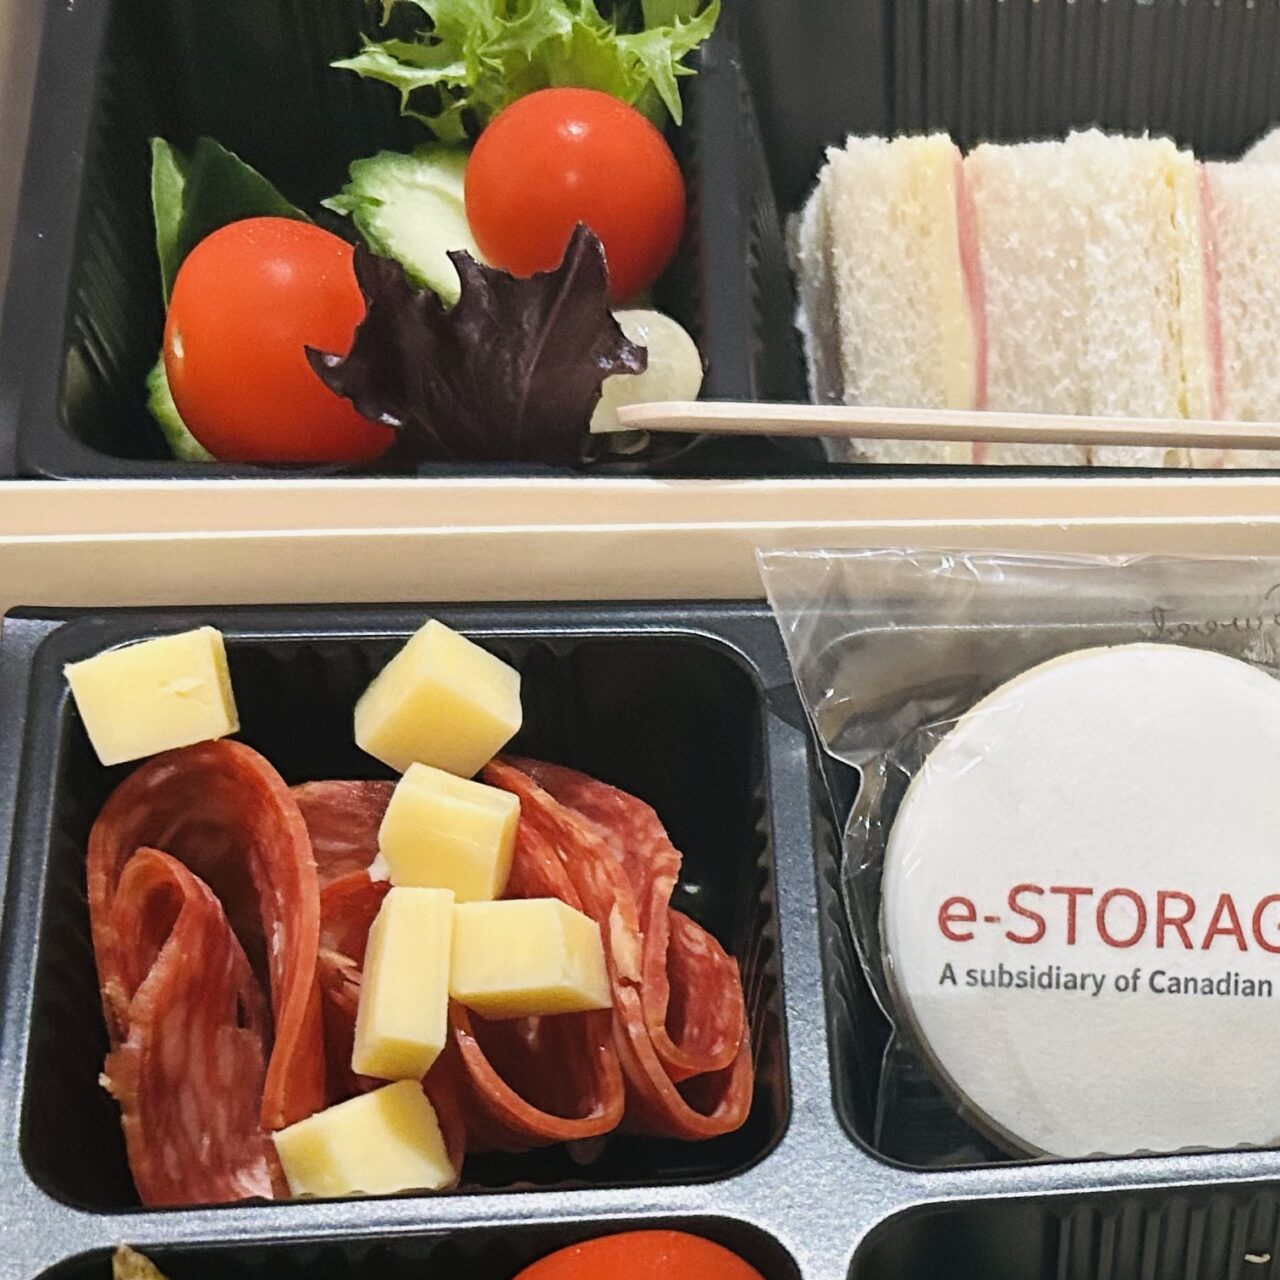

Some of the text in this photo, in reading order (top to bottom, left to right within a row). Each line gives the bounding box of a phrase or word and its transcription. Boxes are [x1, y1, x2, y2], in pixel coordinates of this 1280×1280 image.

[939, 962, 958, 986] A
[966, 963, 1106, 997] subsidiary
[1114, 967, 1141, 993] of
[1148, 969, 1273, 998] Canadian
